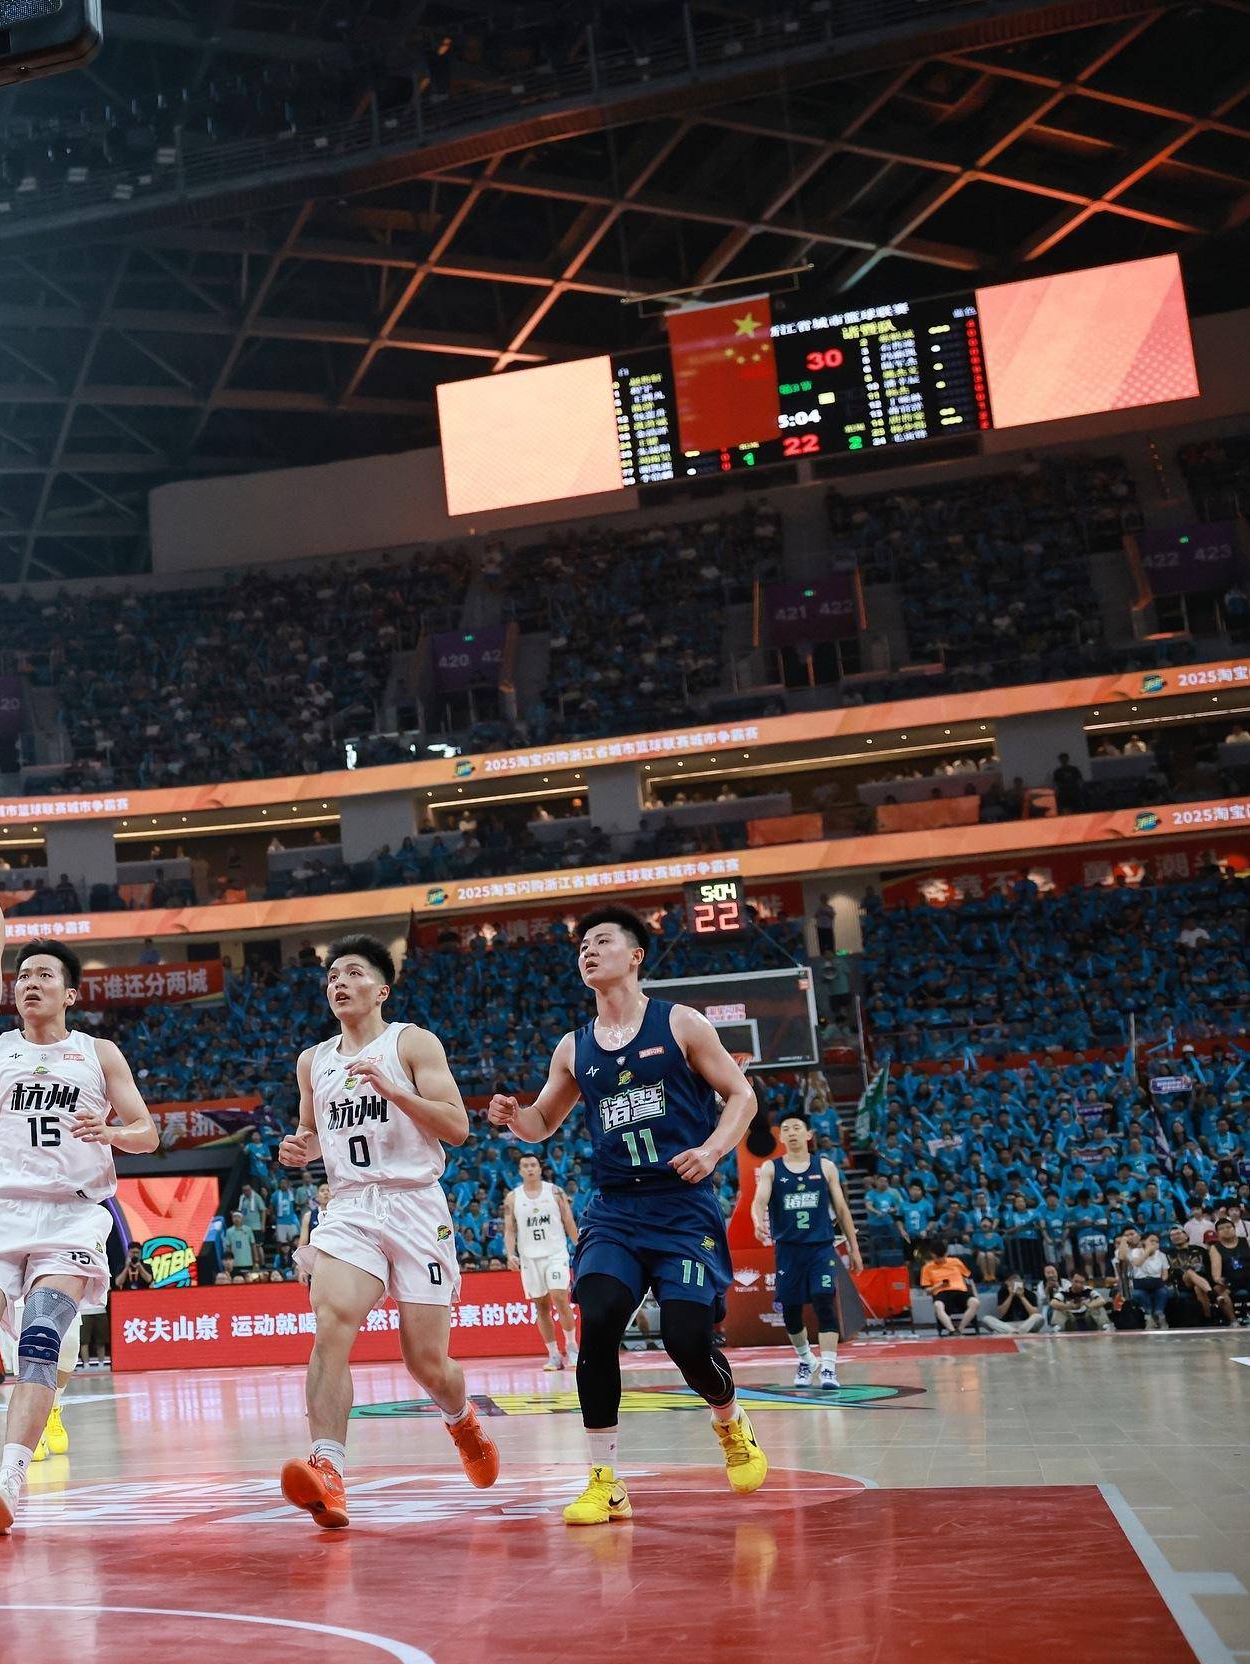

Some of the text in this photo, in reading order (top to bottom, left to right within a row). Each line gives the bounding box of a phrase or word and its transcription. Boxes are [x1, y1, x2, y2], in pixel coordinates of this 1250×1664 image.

[805, 348, 844, 371] 30
[778, 409, 822, 429] 5:04
[782, 433, 821, 457] 22
[848, 435, 863, 451] 2
[743, 452, 755, 466] 1
[1177, 665, 1250, 687] 2025淘宝
[693, 902, 740, 933] 22
[77, 968, 208, 1001] 下谁还分两城
[10, 1082, 81, 1113] 杭州
[600, 1079, 665, 1133] 诸暨
[327, 1095, 390, 1131] 杭州
[27, 1116, 62, 1147] 15
[348, 1134, 371, 1167] 0
[621, 1127, 659, 1167] 11
[796, 1211, 810, 1229] 2
[427, 1262, 442, 1285] 0
[681, 1259, 706, 1287] 11
[821, 1274, 832, 1288] 2
[123, 1313, 219, 1345] 农夫山泉
